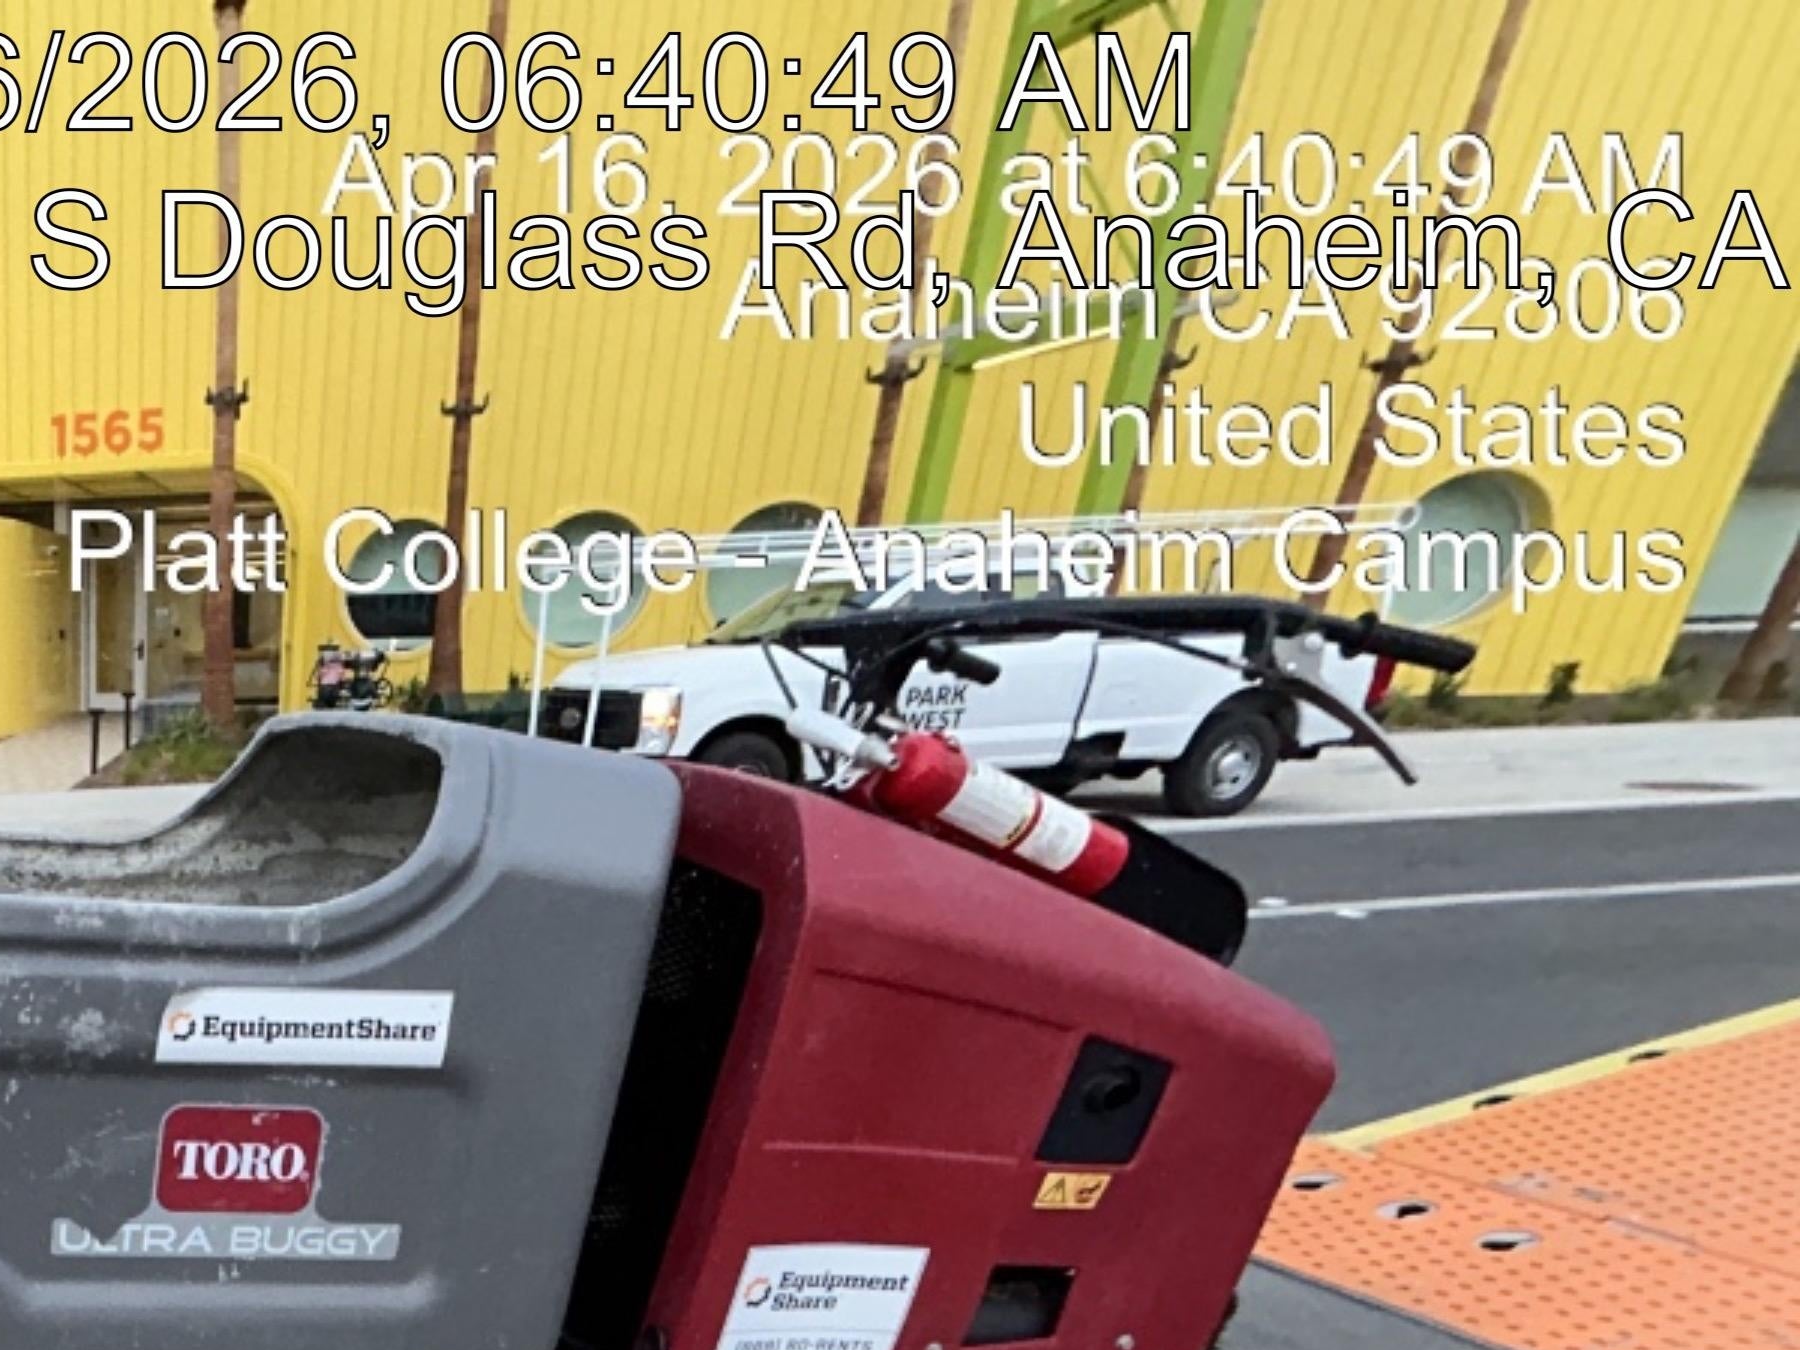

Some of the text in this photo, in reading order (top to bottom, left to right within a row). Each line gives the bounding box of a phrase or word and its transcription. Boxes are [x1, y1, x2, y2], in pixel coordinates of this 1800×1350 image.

[51, 407, 165, 459] 1565
[905, 684, 969, 708] PARK
[902, 708, 967, 731] WEST
[202, 1016, 437, 1044] EquipmentShare
[173, 1139, 306, 1182] TORO
[229, 1226, 390, 1256] BUGGY
[778, 1271, 910, 1292] Equipment
[770, 1292, 839, 1311] Share
